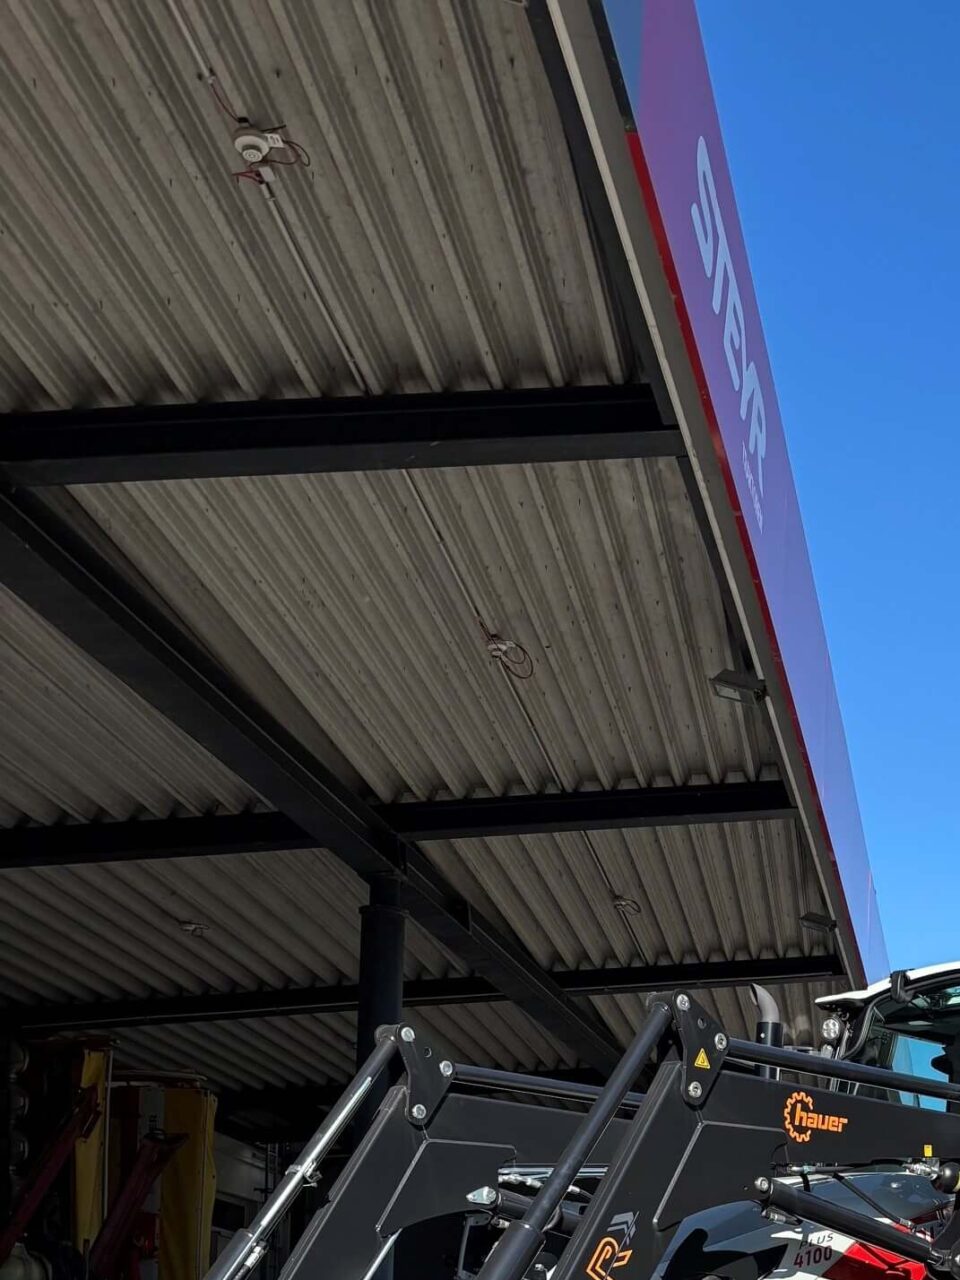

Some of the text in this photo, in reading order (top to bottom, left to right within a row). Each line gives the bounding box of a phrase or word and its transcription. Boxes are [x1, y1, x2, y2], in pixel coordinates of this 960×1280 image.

[691, 136, 765, 497] STEYR
[794, 1103, 848, 1132] hauer
[799, 1233, 834, 1250] PLUS
[793, 1245, 833, 1268] 4100
